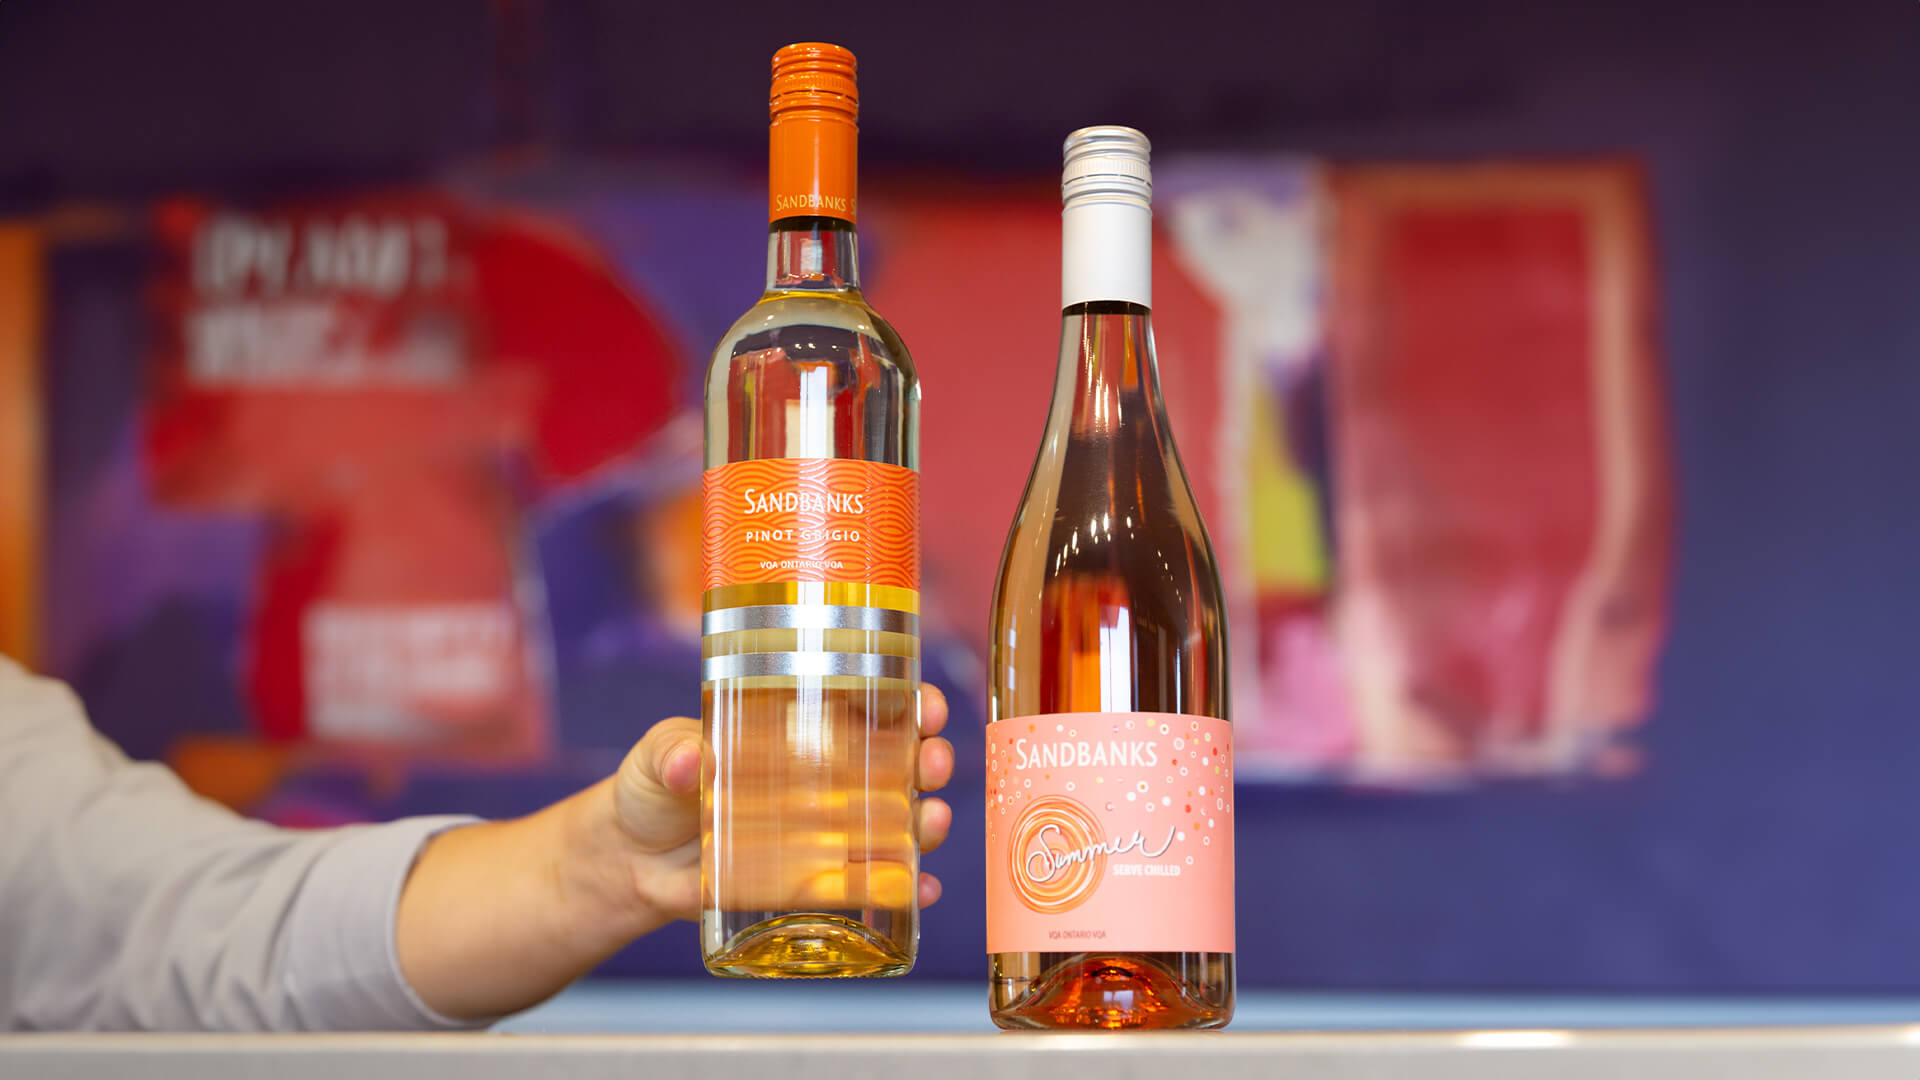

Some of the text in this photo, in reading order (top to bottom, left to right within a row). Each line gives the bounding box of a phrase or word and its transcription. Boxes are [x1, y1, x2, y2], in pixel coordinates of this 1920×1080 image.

[776, 193, 847, 212] SANDBANKS
[744, 488, 864, 515] SANDBANKS
[746, 529, 860, 543] PINOT GRIGIO
[760, 560, 844, 569] VQA ONTARIO VQA
[1016, 738, 1158, 770] SANDBANKS
[1026, 824, 1176, 882] Summer
[1113, 864, 1181, 876] SERVE CHILLED
